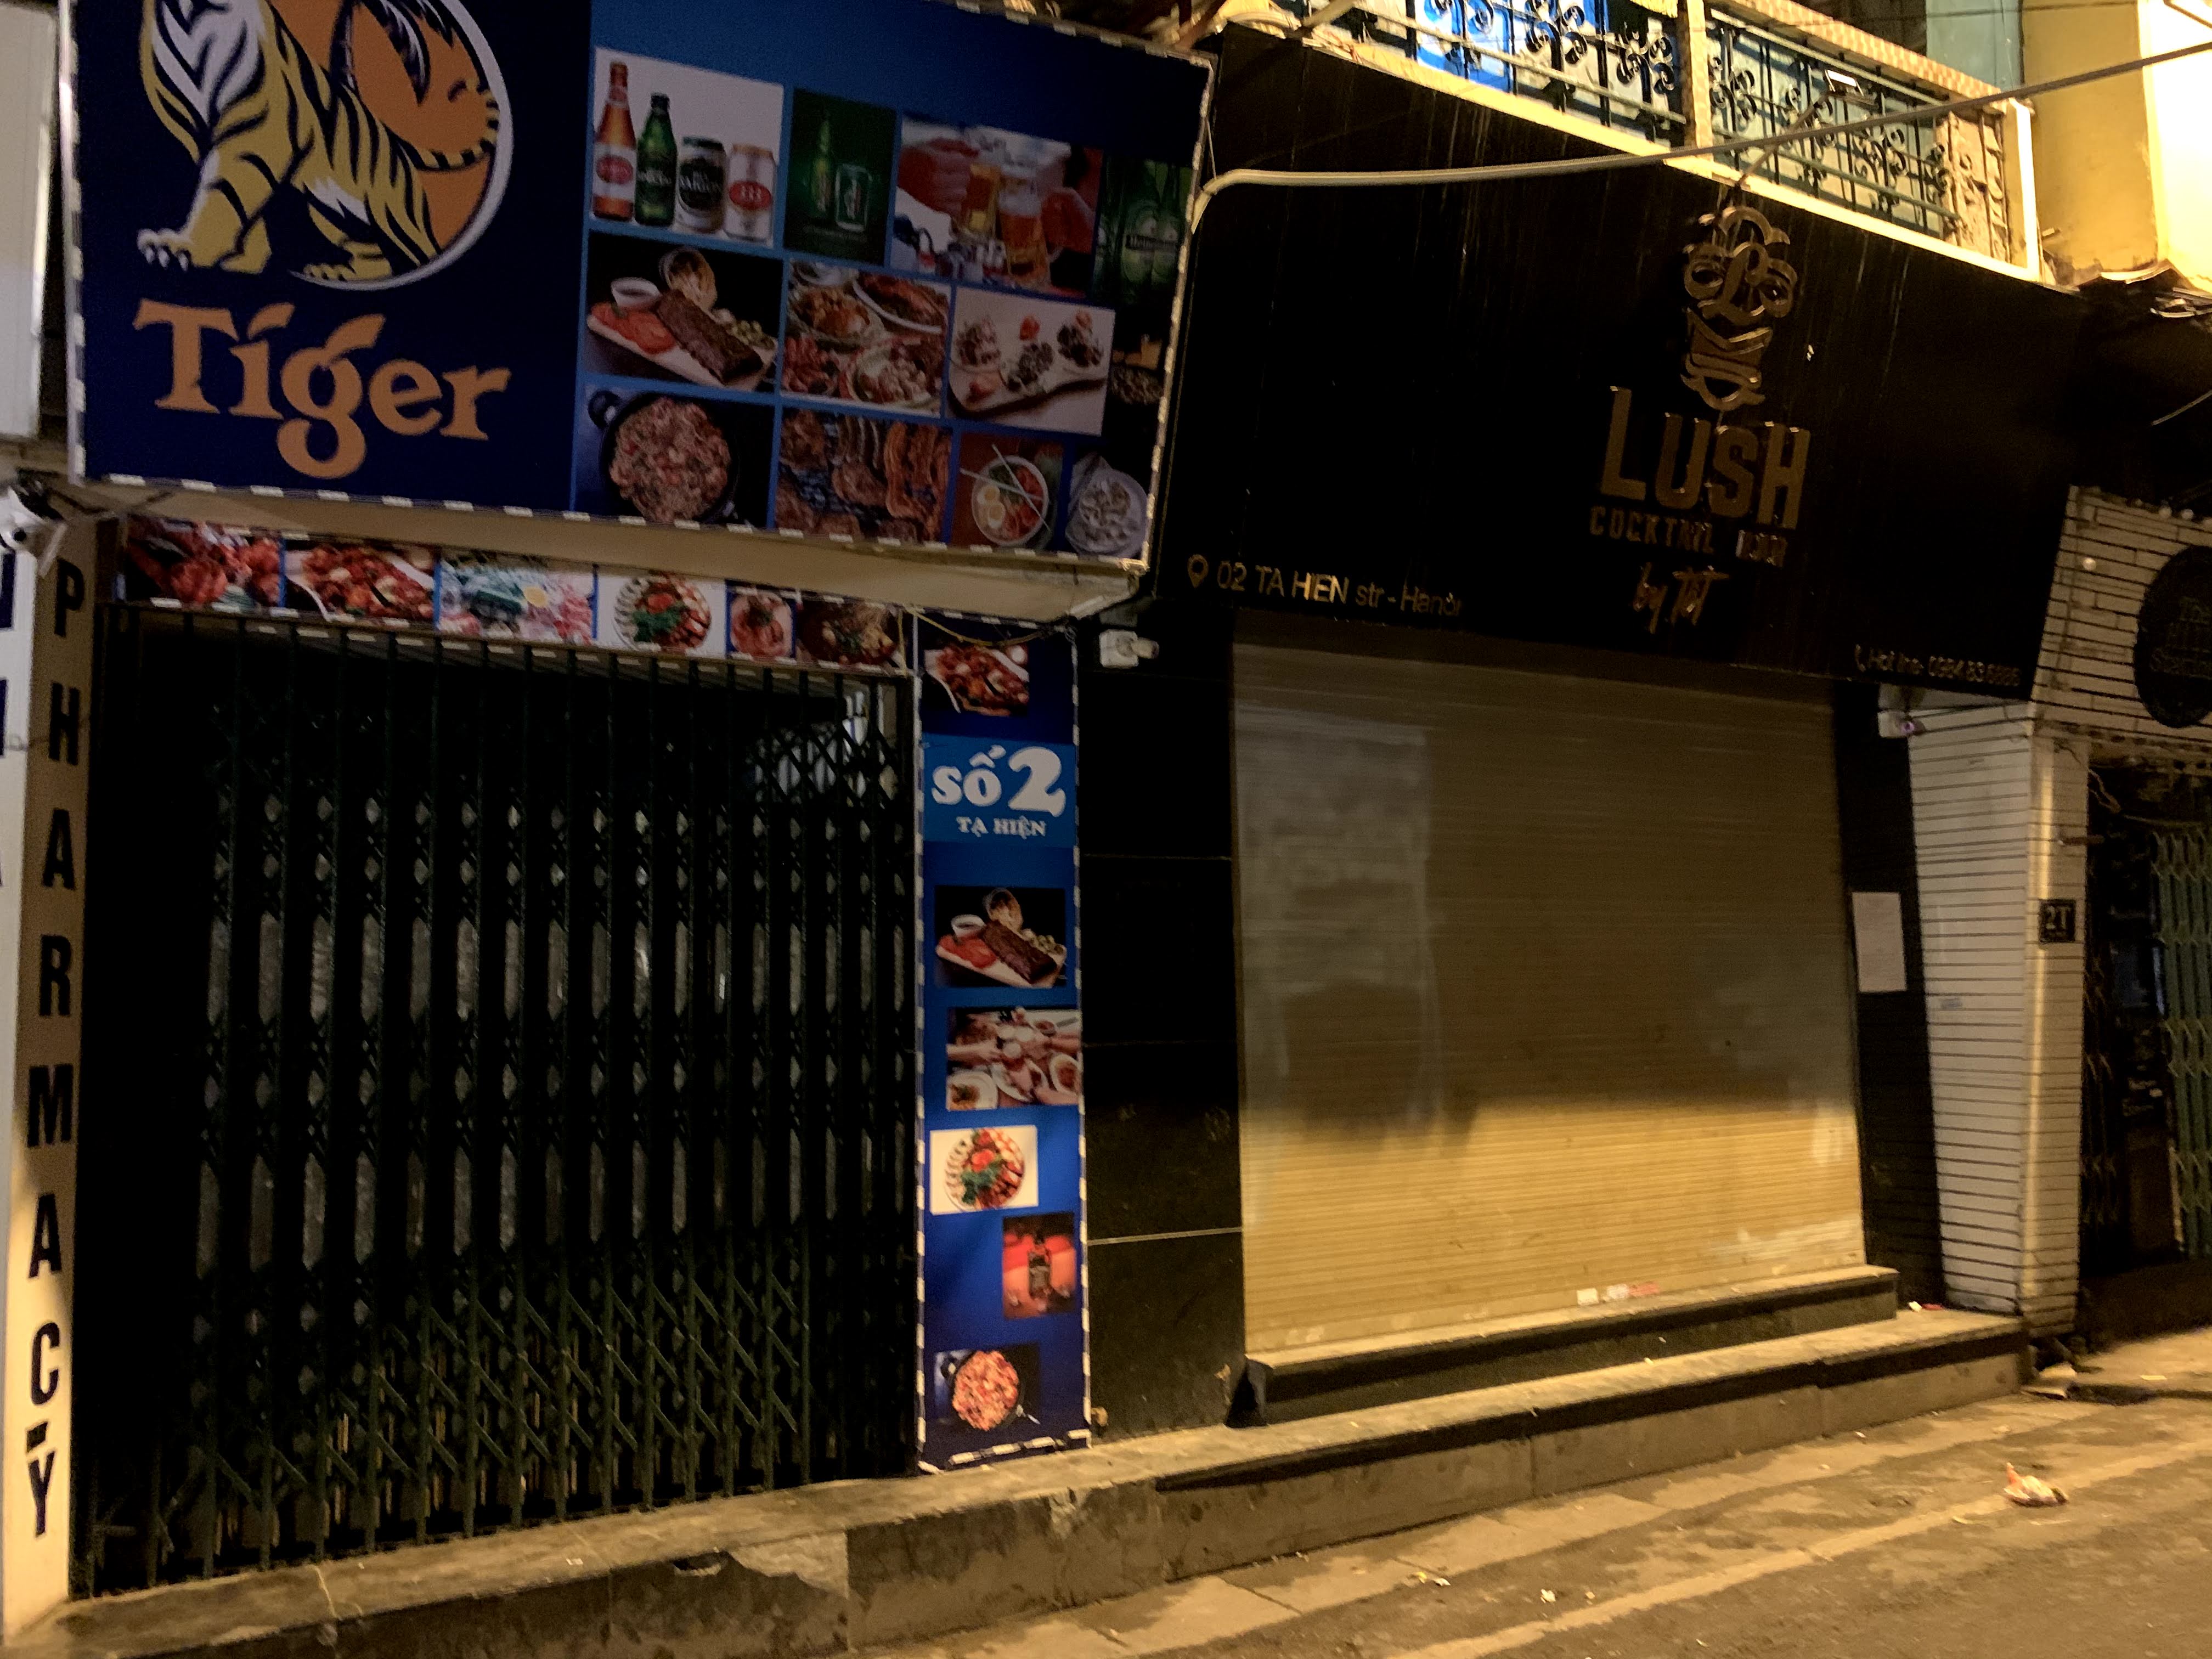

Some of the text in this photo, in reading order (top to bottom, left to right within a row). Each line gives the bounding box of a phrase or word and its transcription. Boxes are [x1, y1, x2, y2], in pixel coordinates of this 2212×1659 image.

[132, 298, 512, 480] Tiger
[1600, 386, 1810, 531] LUSH
[1589, 504, 1716, 555] COCKTAIL
[1216, 558, 1247, 592] 02
[1255, 565, 1285, 596] TA
[1355, 579, 1386, 608] str
[1008, 746, 1066, 818] 2
